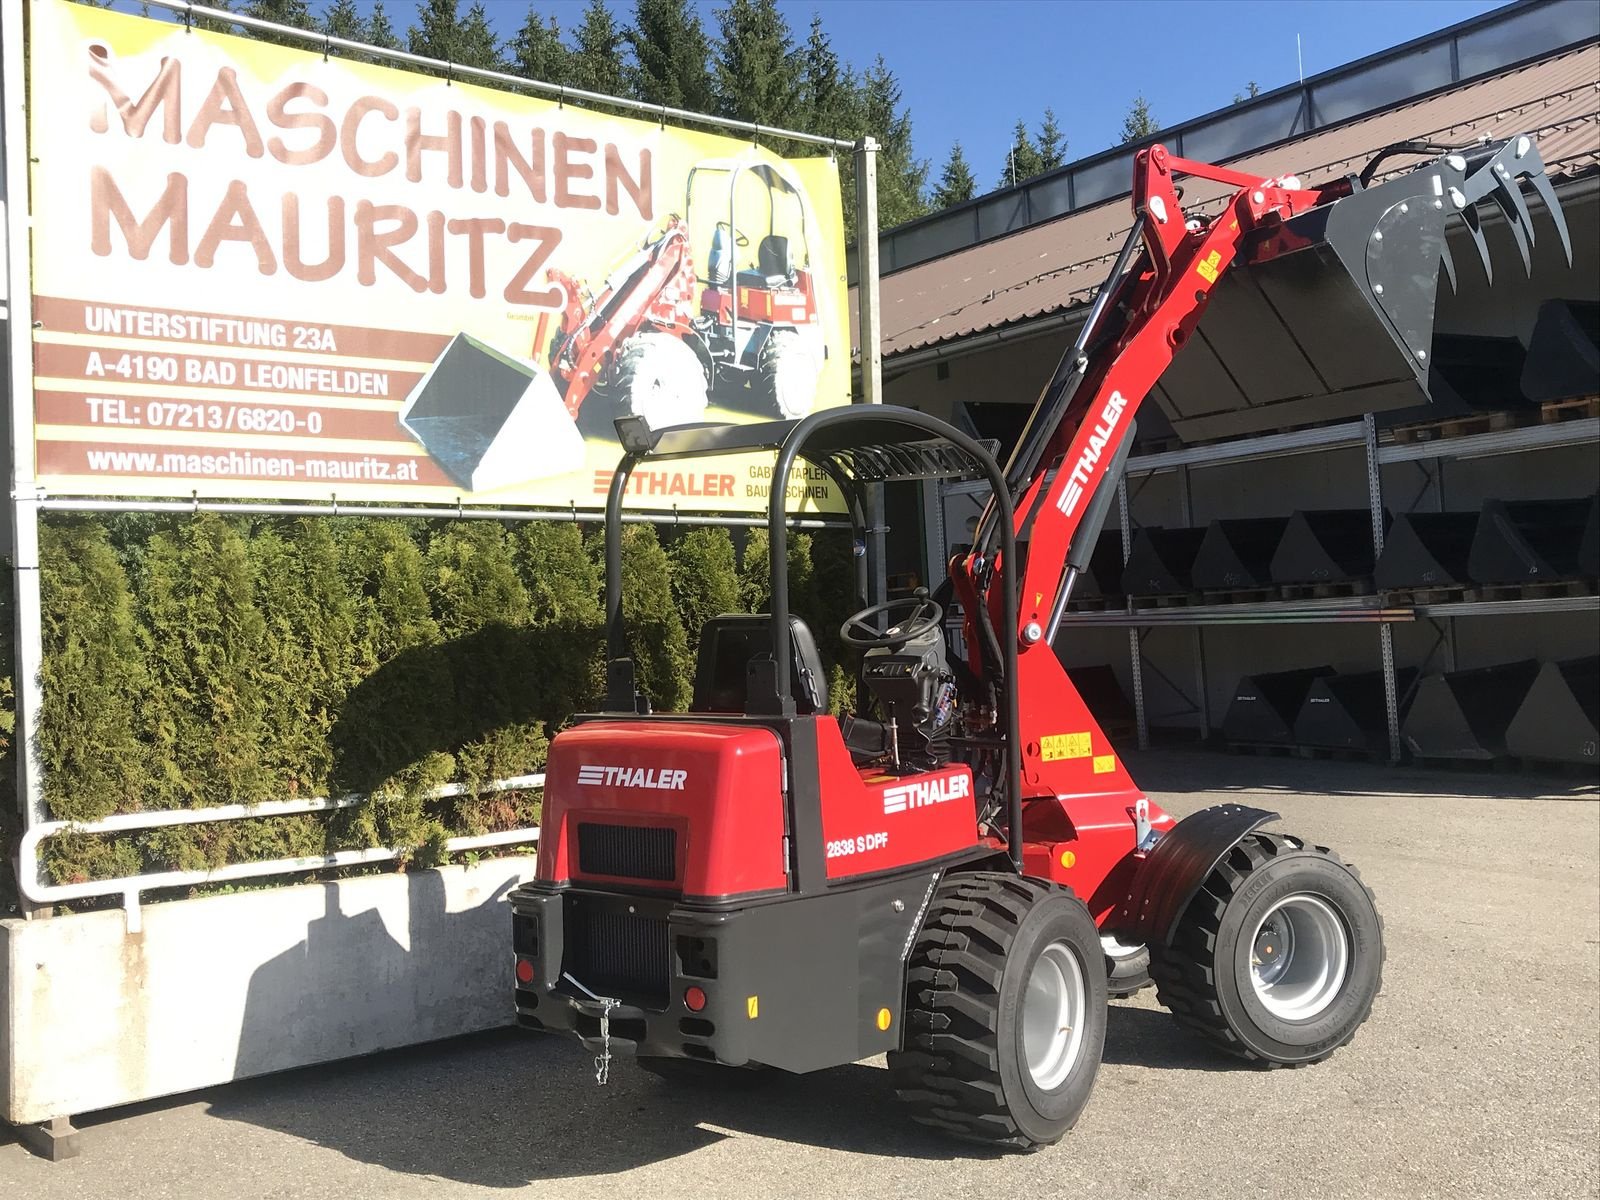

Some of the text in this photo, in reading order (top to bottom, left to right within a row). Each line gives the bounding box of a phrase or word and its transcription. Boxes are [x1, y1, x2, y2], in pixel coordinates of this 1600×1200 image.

[88, 44, 654, 221] MASCHINEN
[91, 165, 563, 309] MAURITZ
[84, 306, 337, 351] UNTERSTIFTUNG 23A
[85, 351, 389, 396] A-4190 BAD LEONFELDEN
[86, 397, 322, 434] TEL: 07213/6820-0
[1070, 390, 1128, 485] THALER
[87, 450, 419, 481] www.maschinen-mauritz.at
[749, 465, 828, 481] GABTAPLER
[632, 470, 735, 497] THALER
[746, 484, 829, 499] BAUSCHINEN
[604, 766, 688, 790] THALER
[906, 774, 970, 809] THALER
[826, 838, 855, 858] 2838
